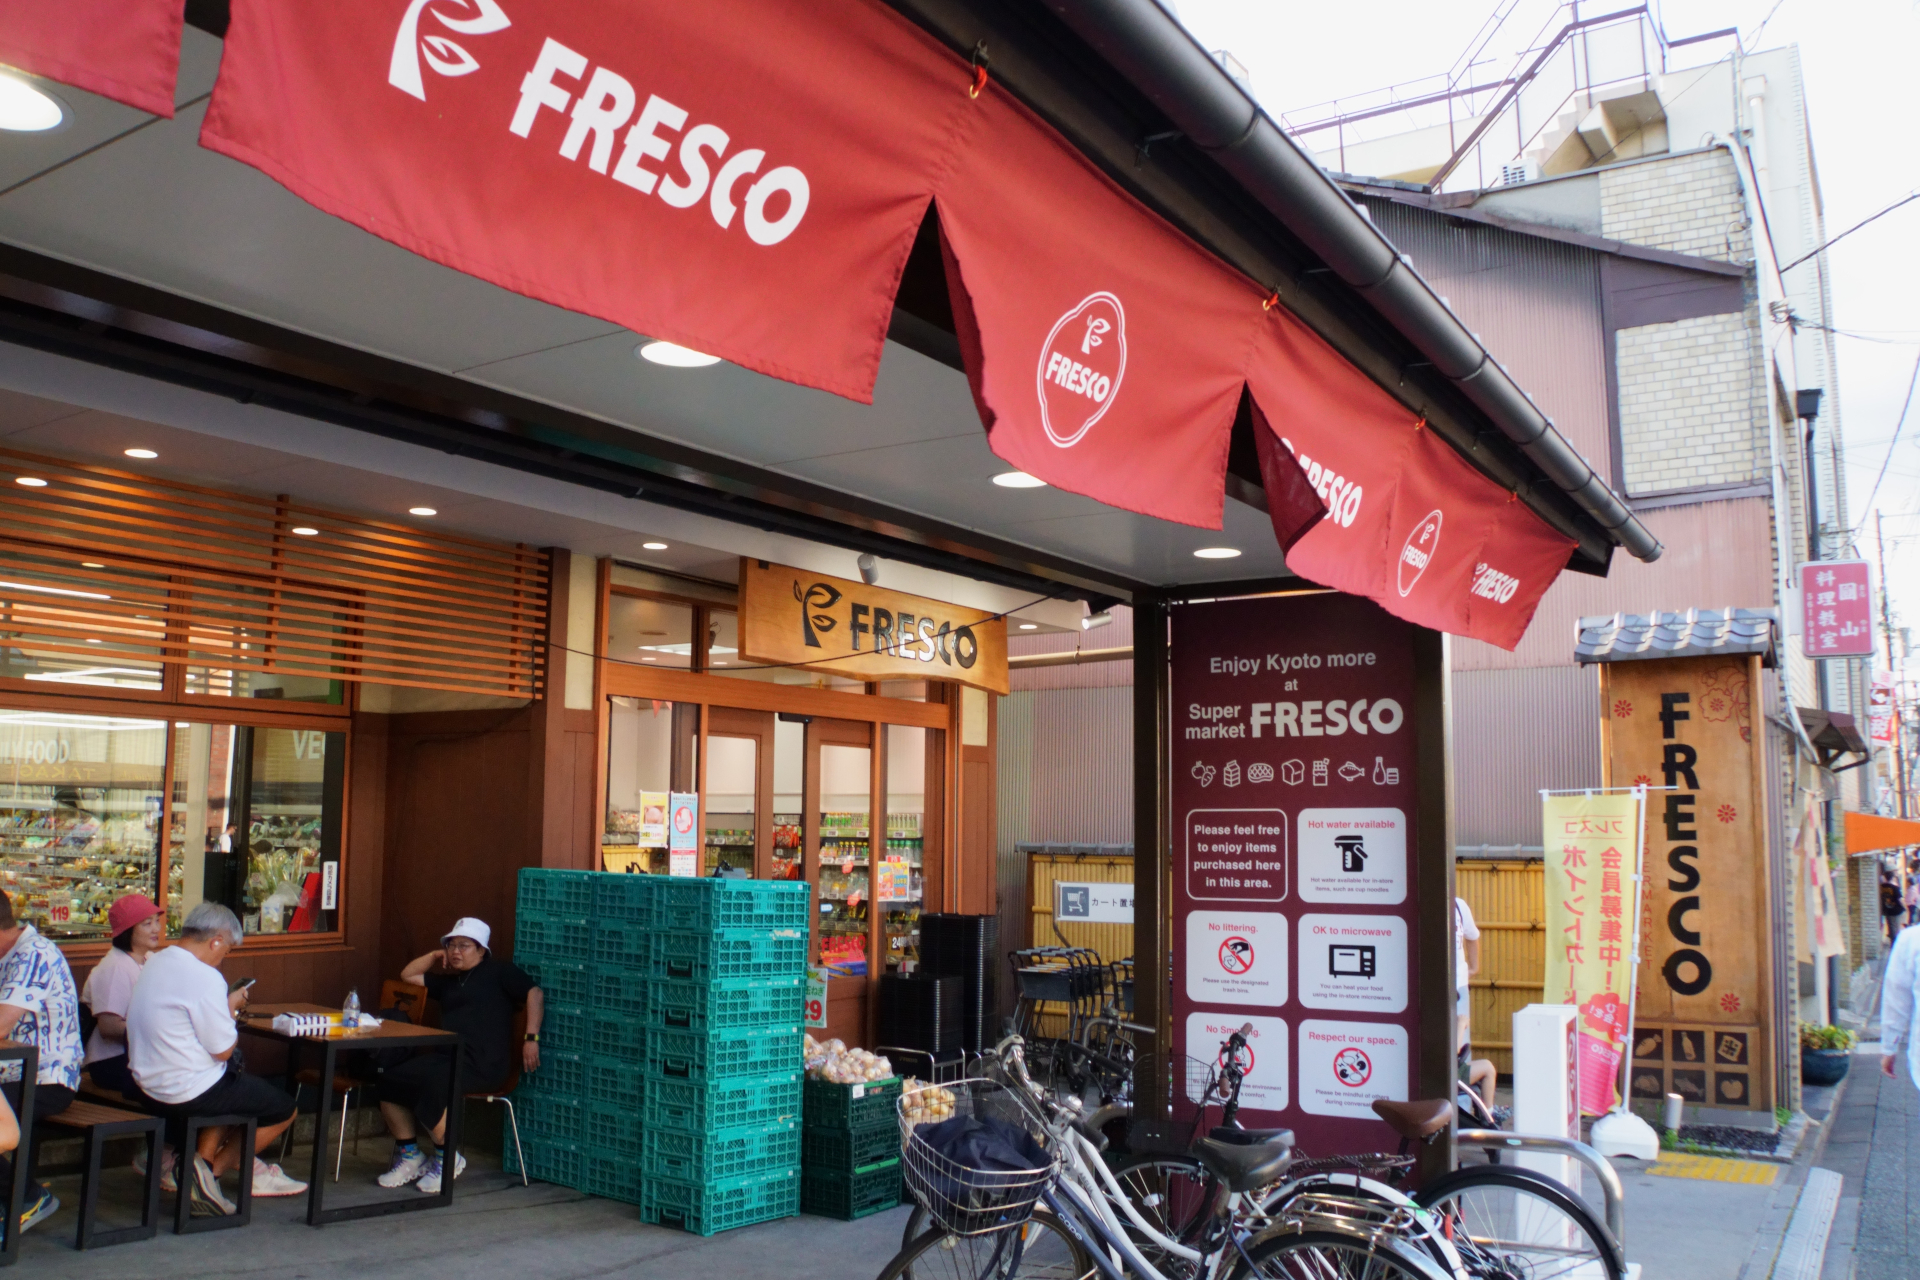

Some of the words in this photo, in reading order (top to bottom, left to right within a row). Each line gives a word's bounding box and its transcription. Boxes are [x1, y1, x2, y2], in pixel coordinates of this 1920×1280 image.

[509, 37, 810, 246] FRESCO
[1045, 351, 1110, 403] FRESCO
[1402, 545, 1428, 569] FRESCO
[1472, 567, 1519, 604] FRESCO
[1816, 570, 1838, 648] 料理教室
[850, 602, 978, 669] FRESCO
[1210, 656, 1261, 676] Enjoy
[1266, 652, 1321, 674] Kyoto
[1327, 651, 1376, 668] more
[1284, 678, 1298, 691] at
[1189, 703, 1241, 720] Super
[1250, 697, 1404, 738] FRESCO
[1185, 722, 1246, 740] market
[25, 739, 70, 764] FOOD
[1194, 824, 1231, 835] Please
[1234, 824, 1254, 835] feel
[1258, 824, 1280, 835] free
[1308, 820, 1324, 829] Hot
[1326, 821, 1351, 829] water
[1354, 820, 1395, 829] available
[1197, 842, 1208, 852] to
[1212, 842, 1242, 854] enjoy
[1245, 842, 1277, 853] items
[1659, 692, 1712, 996] FRESCO
[1194, 860, 1252, 871] purchased
[1255, 860, 1281, 870] here
[1205, 876, 1216, 887] in
[1219, 877, 1240, 887] this
[1244, 879, 1272, 888] area.
[51, 905, 69, 922] 119
[1208, 922, 1221, 931] No
[1223, 923, 1258, 934] littering.
[1312, 925, 1327, 934] OK
[1329, 926, 1339, 935] to
[1341, 927, 1392, 936] microwave
[1206, 1025, 1218, 1033] No
[1220, 1025, 1261, 1038] Smog.
[1309, 1031, 1346, 1043] Respect
[1348, 1035, 1364, 1043] our
[1367, 1036, 1398, 1046] space.
